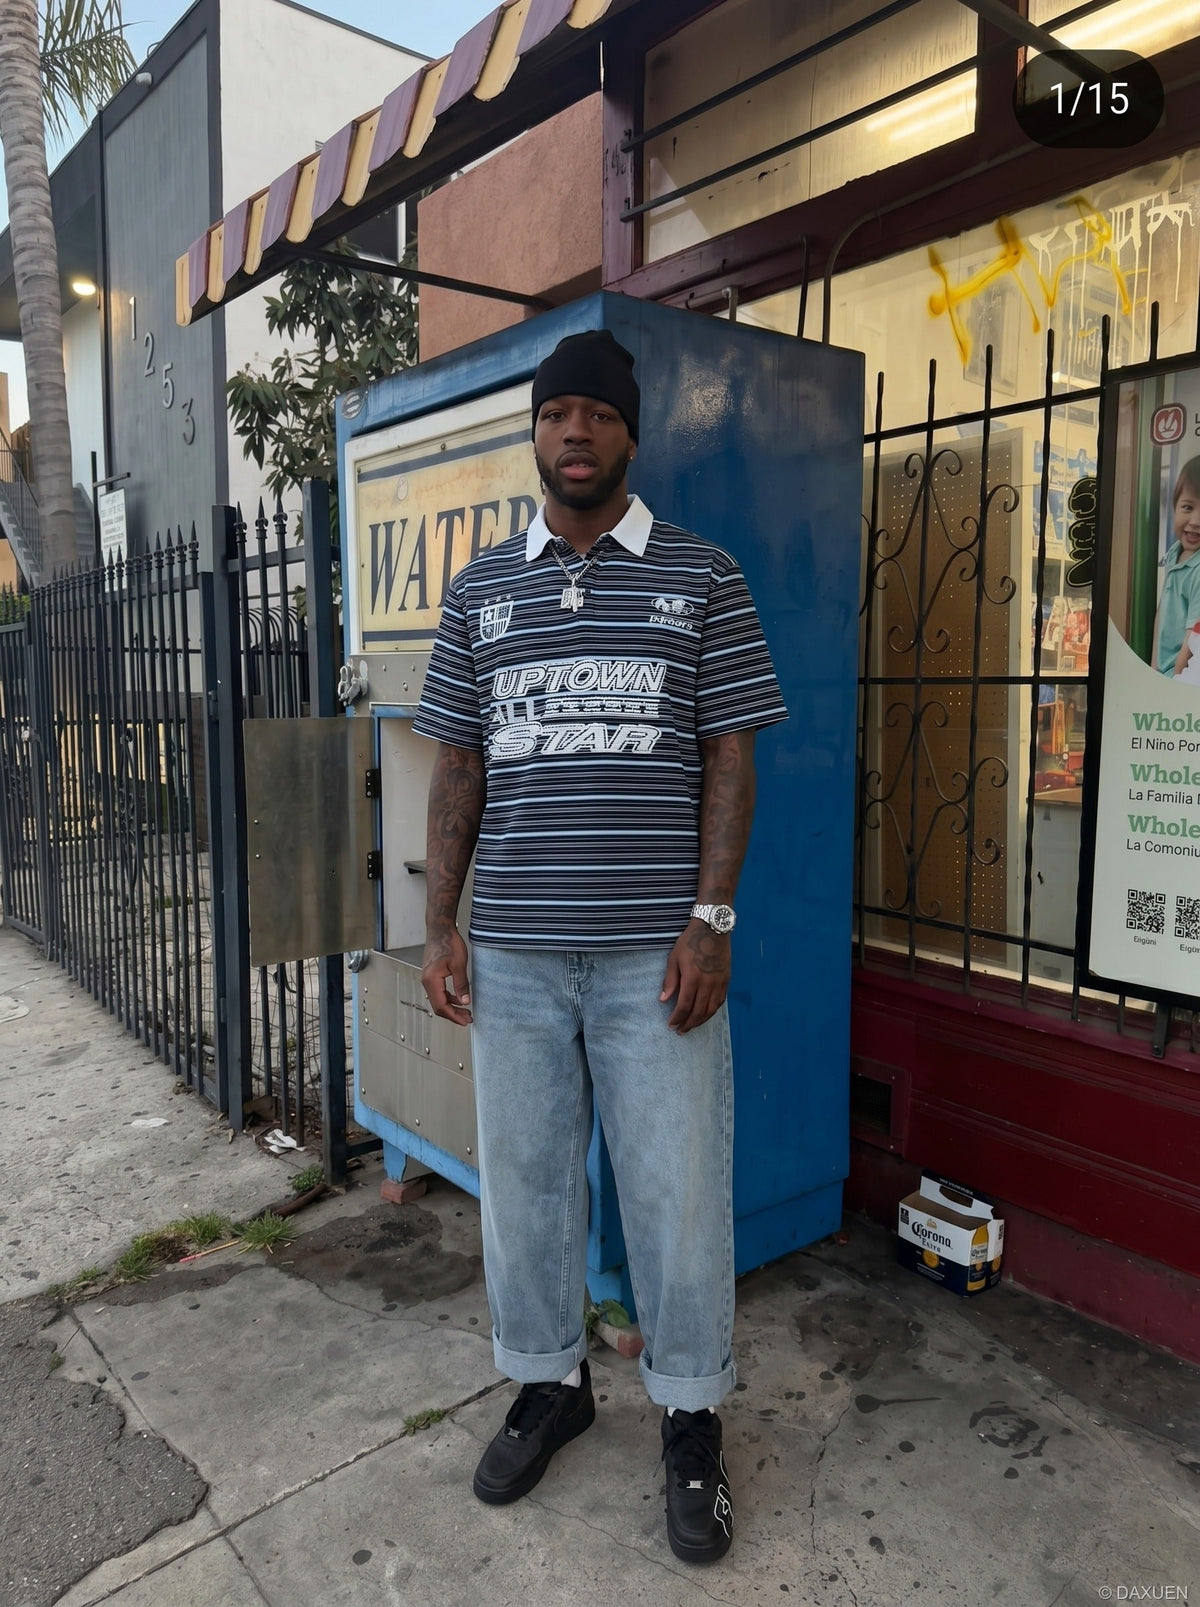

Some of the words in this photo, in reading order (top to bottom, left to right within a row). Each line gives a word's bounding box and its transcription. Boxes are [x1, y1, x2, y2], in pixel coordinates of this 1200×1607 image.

[491, 659, 667, 700] UPTOWN
[491, 699, 543, 724] ALL
[490, 721, 662, 759] STAR
[1131, 737, 1142, 749] El
[1130, 763, 1200, 786] Whole
[1128, 788, 1143, 801] La
[1147, 790, 1193, 805] Familia
[1127, 814, 1200, 839] Whole
[1126, 838, 1141, 851] La
[912, 1221, 952, 1249] Corona
